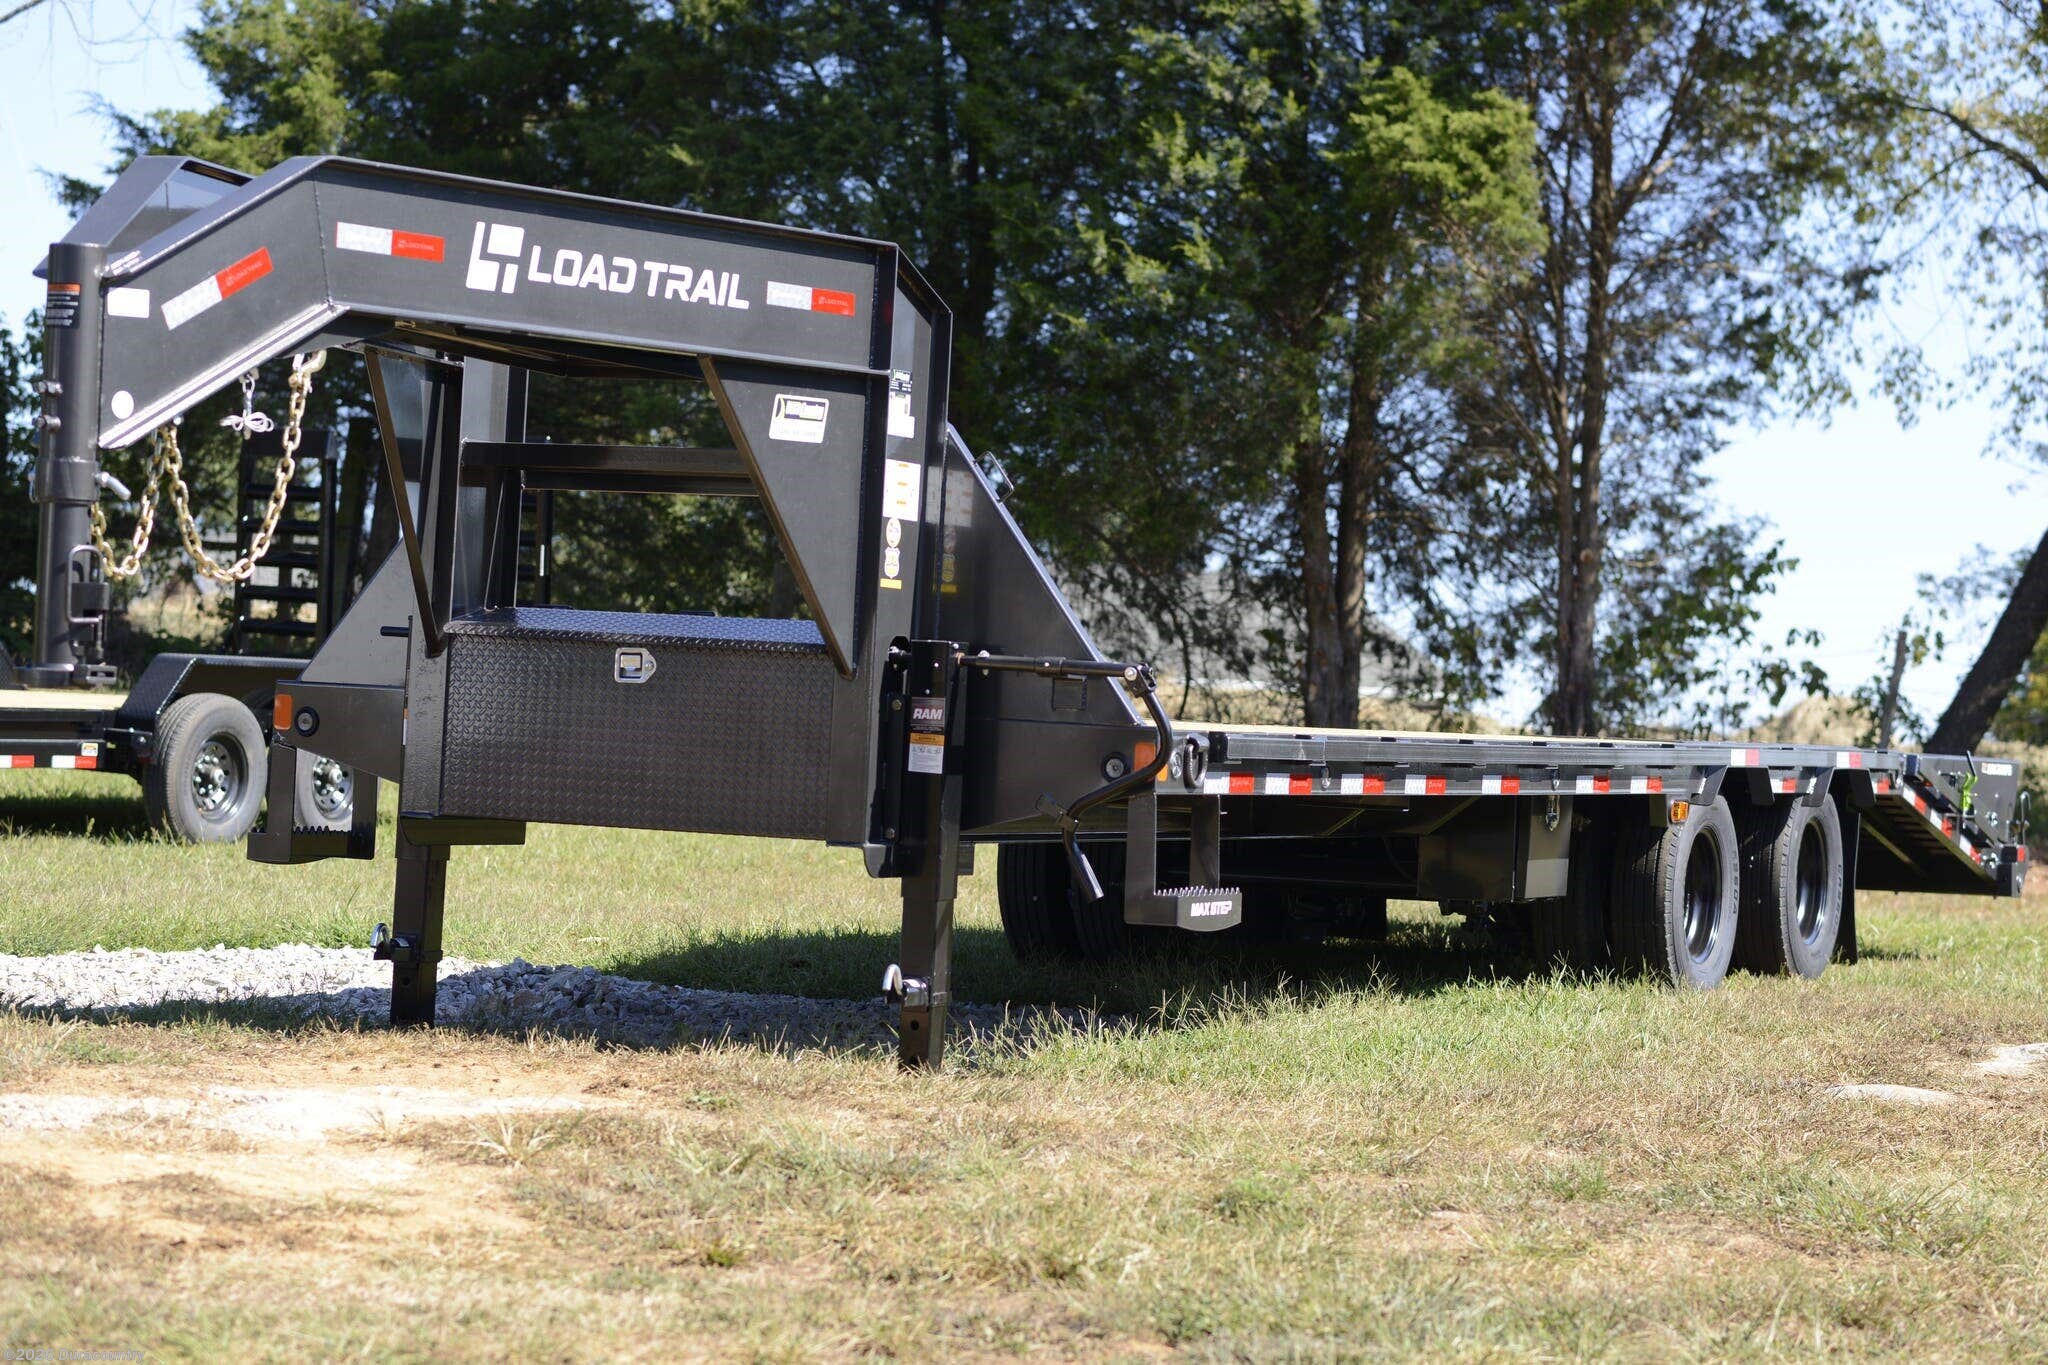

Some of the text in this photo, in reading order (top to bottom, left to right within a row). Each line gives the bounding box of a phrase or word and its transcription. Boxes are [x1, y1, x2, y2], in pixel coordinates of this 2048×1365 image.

[527, 245, 750, 310] LOAD TRAIL
[912, 708, 943, 720] RAM
[1191, 902, 1210, 917] MAX
